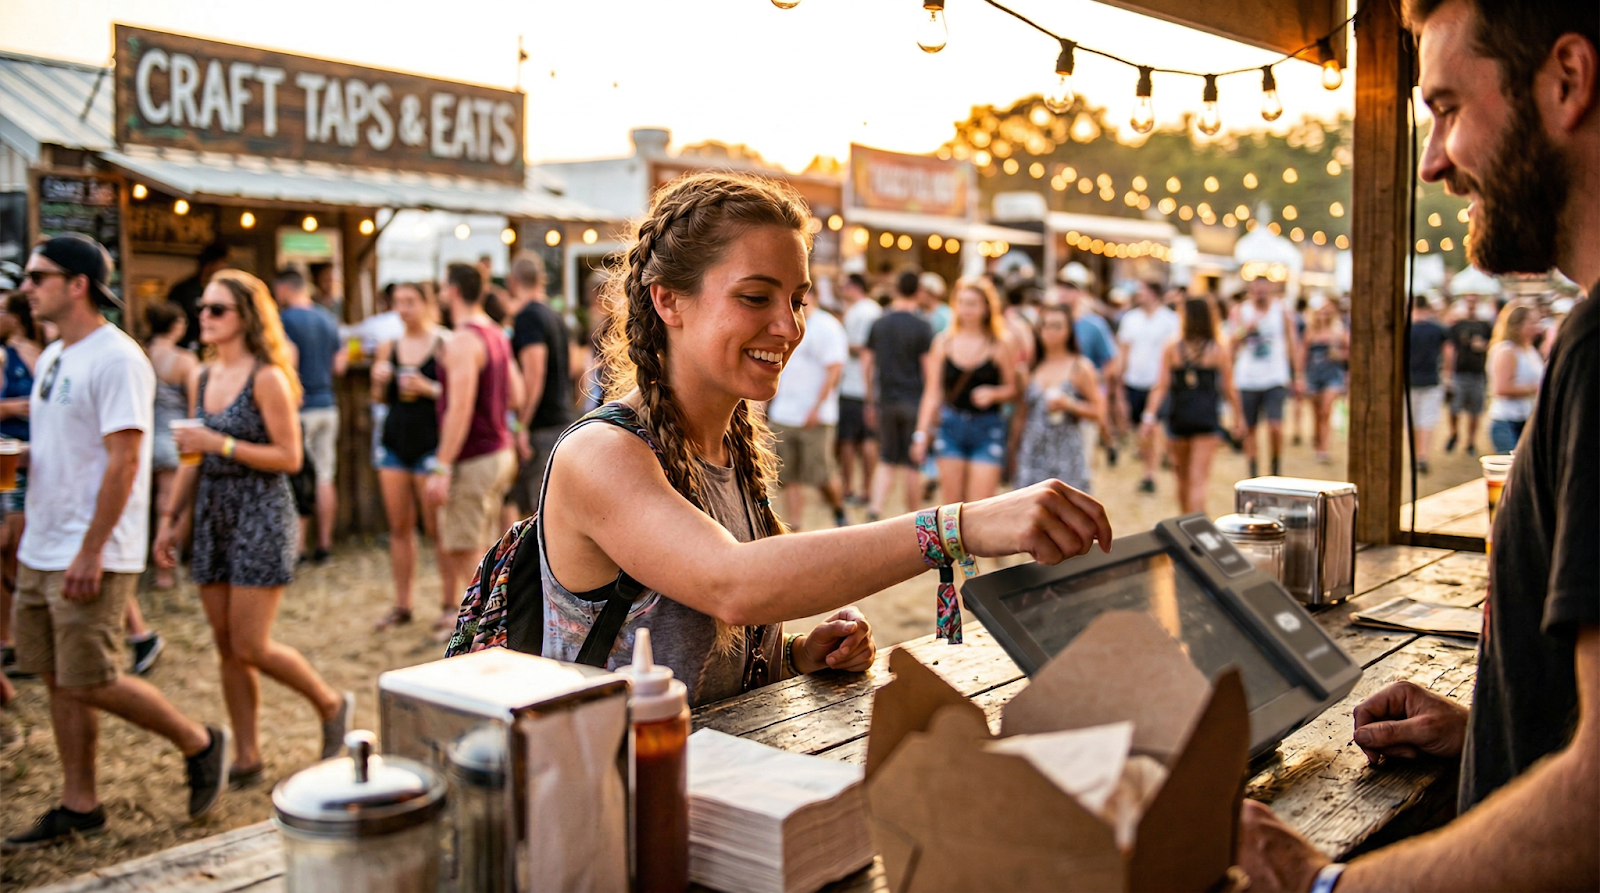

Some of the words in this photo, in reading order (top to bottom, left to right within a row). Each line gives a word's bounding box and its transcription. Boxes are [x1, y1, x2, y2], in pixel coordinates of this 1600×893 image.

[136, 48, 286, 137] CRAFT
[296, 72, 394, 151] TAPS
[399, 94, 427, 146] &
[430, 92, 517, 165] EATS
